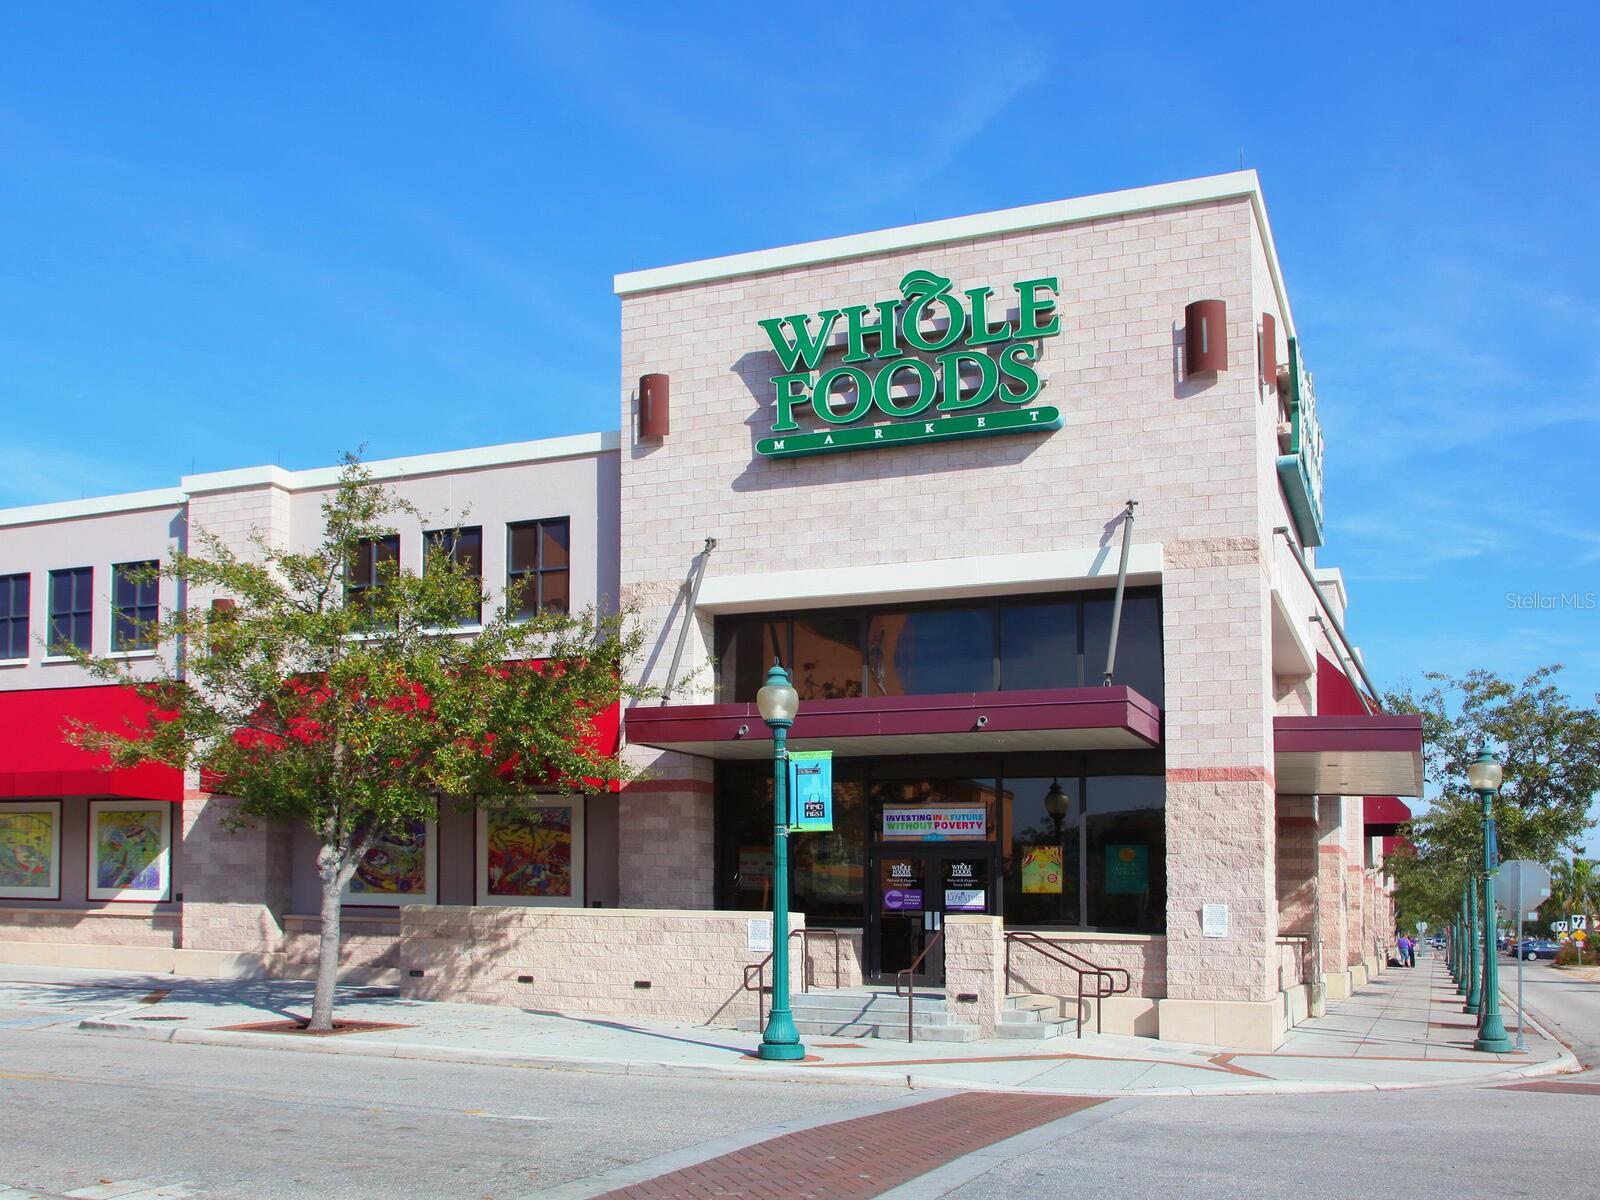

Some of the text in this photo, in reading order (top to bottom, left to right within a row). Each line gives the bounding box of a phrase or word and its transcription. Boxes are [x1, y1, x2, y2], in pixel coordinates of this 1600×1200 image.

[757, 270, 1062, 373] WHOLE
[770, 341, 1041, 432] FOODS
[773, 411, 1040, 450] MARKET
[887, 822, 983, 830] WITHOUT POVERTY
